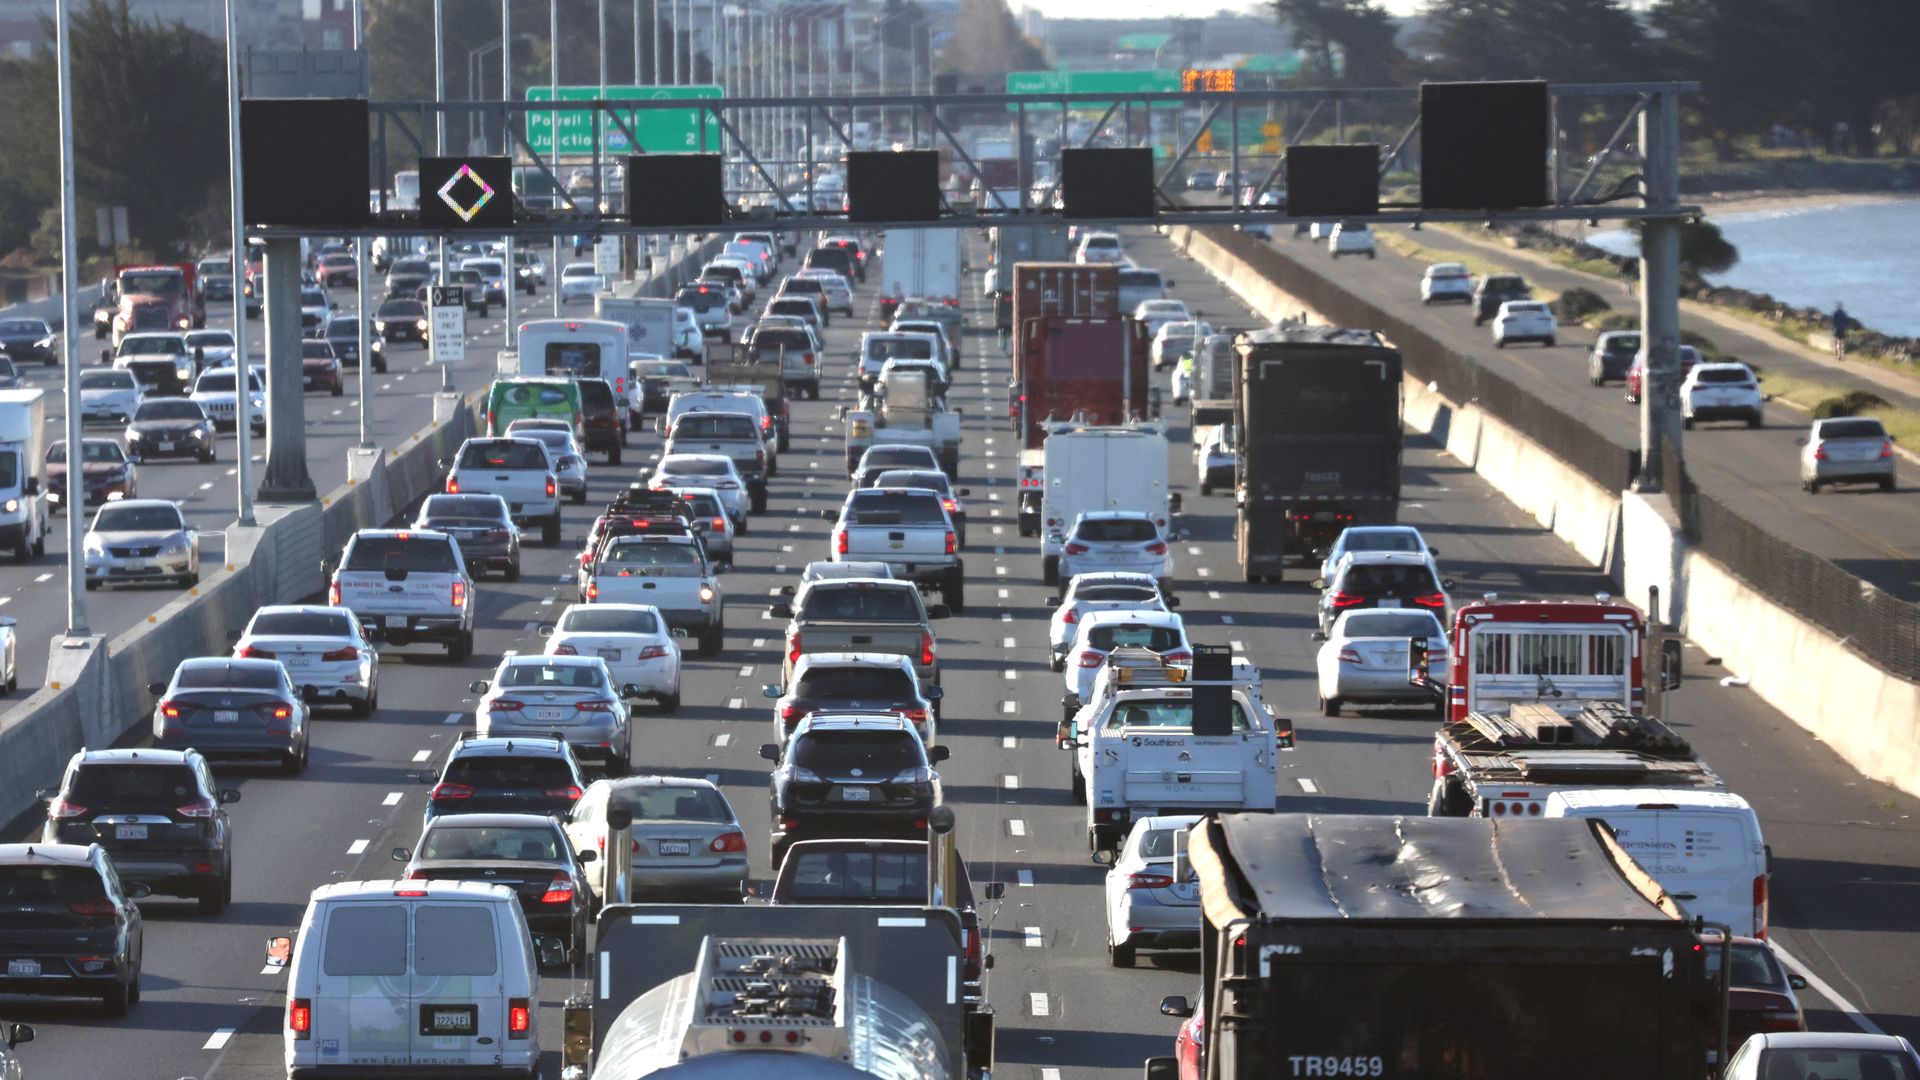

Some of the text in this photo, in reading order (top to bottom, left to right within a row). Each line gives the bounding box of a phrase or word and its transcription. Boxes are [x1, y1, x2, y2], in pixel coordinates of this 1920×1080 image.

[686, 132, 696, 145] 2
[1143, 738, 1185, 747] Southland
[494, 1054, 501, 1065] 5
[1288, 1056, 1383, 1077] TR9459
